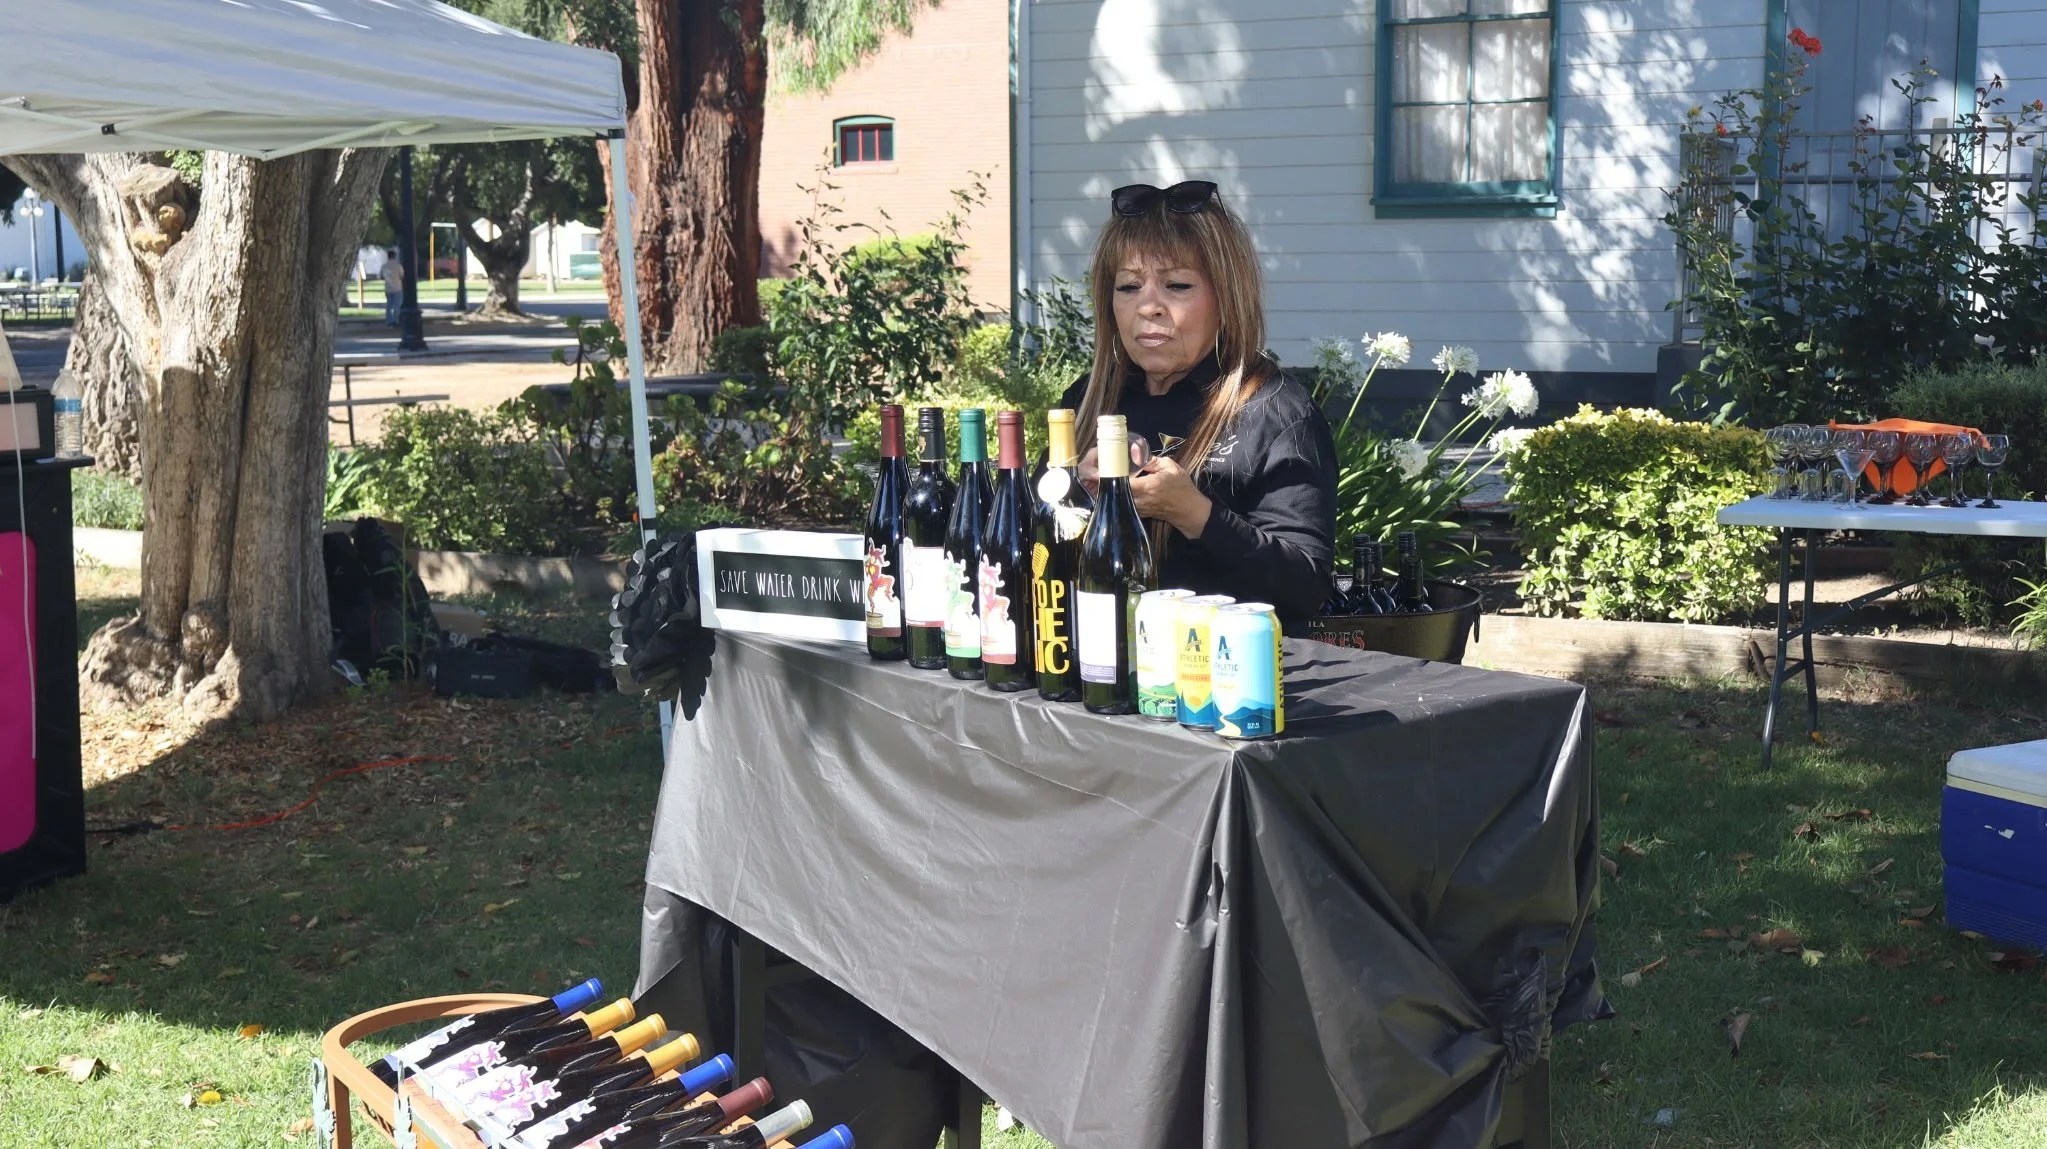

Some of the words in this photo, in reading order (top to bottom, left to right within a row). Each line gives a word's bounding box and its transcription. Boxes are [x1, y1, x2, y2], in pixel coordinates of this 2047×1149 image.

[719, 568, 749, 595] SAVE
[756, 571, 795, 599] WATER
[801, 575, 842, 604] DRINK
[1032, 579, 1065, 608] OP
[1185, 627, 1203, 652] A
[1217, 636, 1232, 660] A
[1035, 640, 1069, 674] IC
